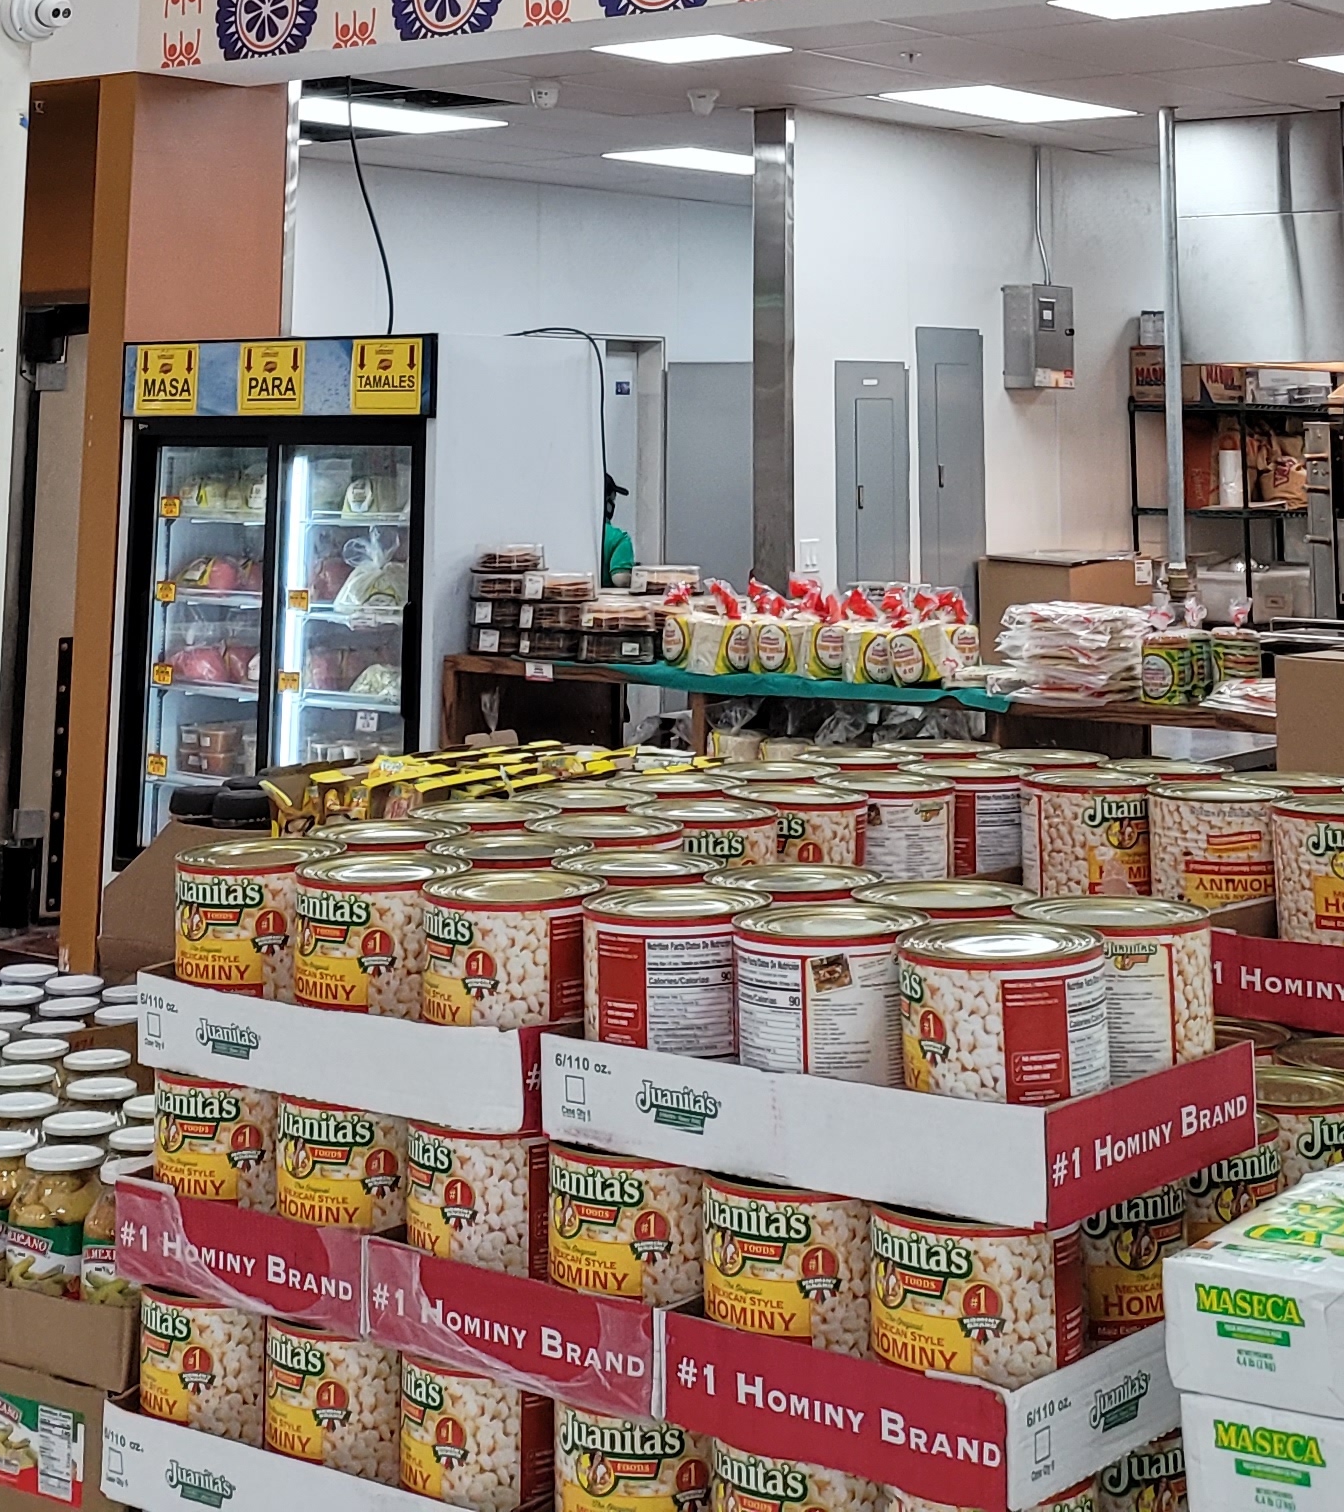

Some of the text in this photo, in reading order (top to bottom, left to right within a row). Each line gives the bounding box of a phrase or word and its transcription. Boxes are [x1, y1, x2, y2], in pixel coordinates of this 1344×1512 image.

[142, 375, 415, 397] MASA PARA TAMALES
[684, 832, 743, 856] nita's
[296, 893, 368, 923] uanita's
[424, 909, 470, 942] nita's
[177, 958, 251, 982] HOMINY
[211, 954, 240, 964] STYLE
[296, 976, 356, 1003] OMINY
[319, 972, 346, 984] STYLE
[720, 971, 732, 983] 90
[424, 998, 460, 1023] MINY
[788, 995, 801, 1007] 90
[196, 1018, 259, 1048] Juanita's
[555, 1053, 612, 1075] 6/110 oz.
[157, 1085, 238, 1120] uanita's
[636, 1079, 719, 1119] Juanita's
[183, 1124, 209, 1135] FOODS
[279, 1103, 373, 1145] Juanita's
[1052, 1093, 1248, 1187] #1 HOMINY BRAND
[314, 1148, 342, 1161] FOODS
[188, 1167, 216, 1180] STYLE
[1187, 1146, 1279, 1195] Juanita
[279, 1192, 360, 1225] HOMINY
[317, 1192, 349, 1207] STYLE
[580, 1205, 610, 1219] FOODS
[1081, 1185, 1185, 1238] Juanita
[640, 1212, 657, 1237] #1
[706, 1189, 808, 1240] Juanita's
[120, 1221, 353, 1302] #1 HOMINY BRAND
[743, 1242, 775, 1257] FOODS
[808, 1248, 825, 1274] #1
[584, 1257, 617, 1272] STYLE
[904, 1274, 936, 1290] FOODS
[707, 1289, 797, 1332] HOMINY
[749, 1296, 784, 1310] STYLE
[969, 1287, 987, 1315] #1
[1105, 1293, 1163, 1319] HOM
[1197, 1284, 1304, 1326] MASECA
[142, 1305, 189, 1340] nita's
[372, 1282, 646, 1379] #1 HOMINY BRAND
[910, 1331, 945, 1348] STYLE
[677, 1357, 1001, 1469] #1 HOMINY BRAND
[1026, 1395, 1072, 1428] 6/110 oz.
[1089, 1369, 1149, 1430] Juanita's
[269, 1427, 312, 1454] MINY
[560, 1410, 682, 1456] Juanita's
[1215, 1421, 1325, 1467] MASECA
[165, 1459, 233, 1500] Juanita's
[616, 1461, 650, 1474] FOODS
[715, 1451, 807, 1498] uanita's
